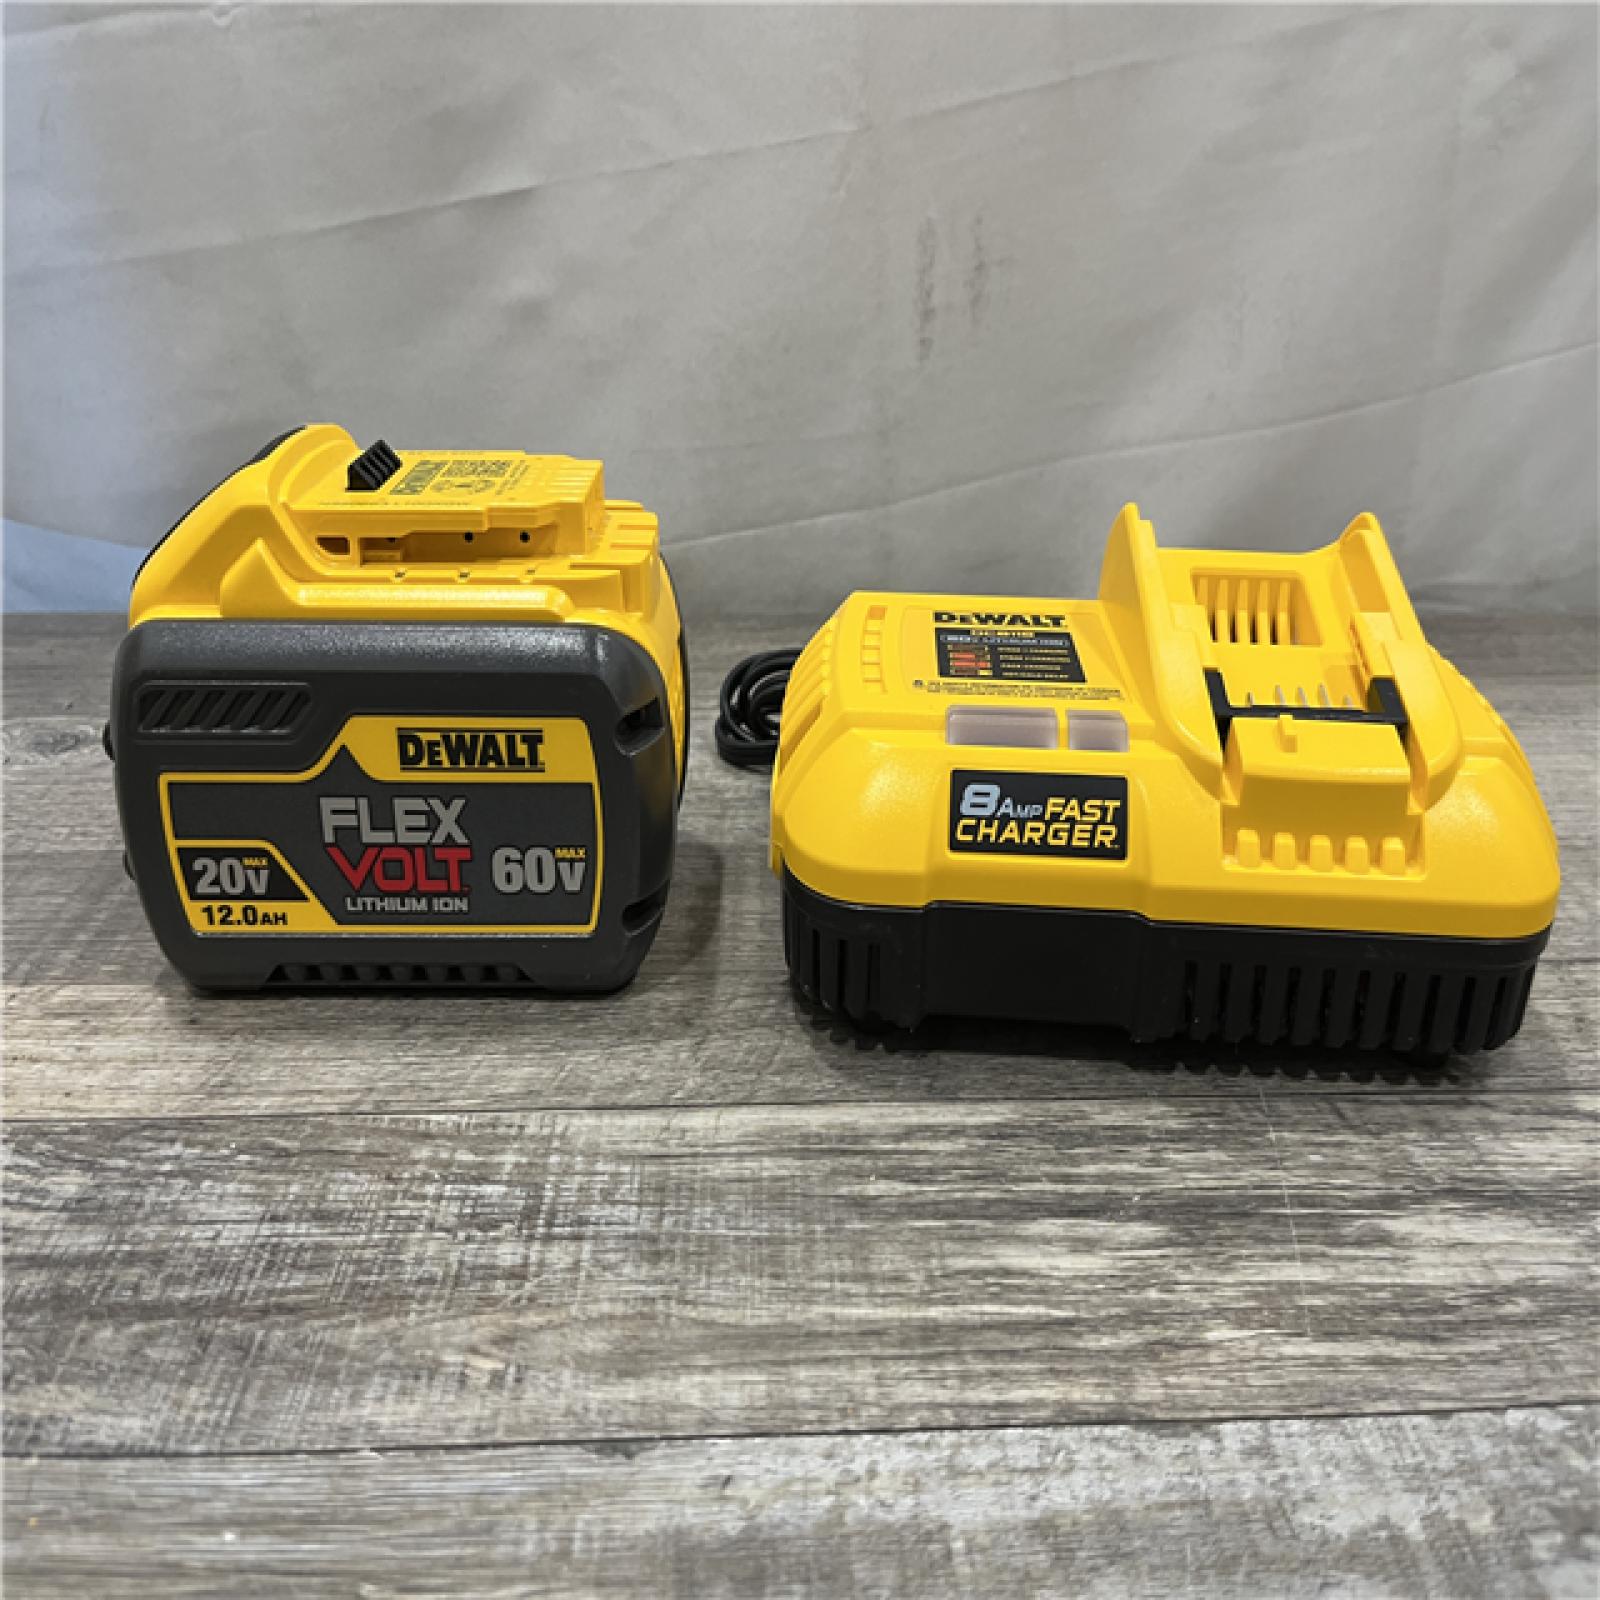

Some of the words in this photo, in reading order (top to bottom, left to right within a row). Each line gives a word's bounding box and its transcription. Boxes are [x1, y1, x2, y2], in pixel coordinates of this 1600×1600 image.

[397, 730, 543, 770] DEWALT
[320, 797, 470, 844] FLEX
[960, 783, 1000, 816] 8
[1044, 797, 1121, 824] FAST
[554, 847, 586, 859] MAX
[956, 819, 1116, 848] CHARGER
[325, 847, 471, 891] VOLT
[346, 896, 428, 912] LITHIUM
[432, 897, 469, 912] ION
